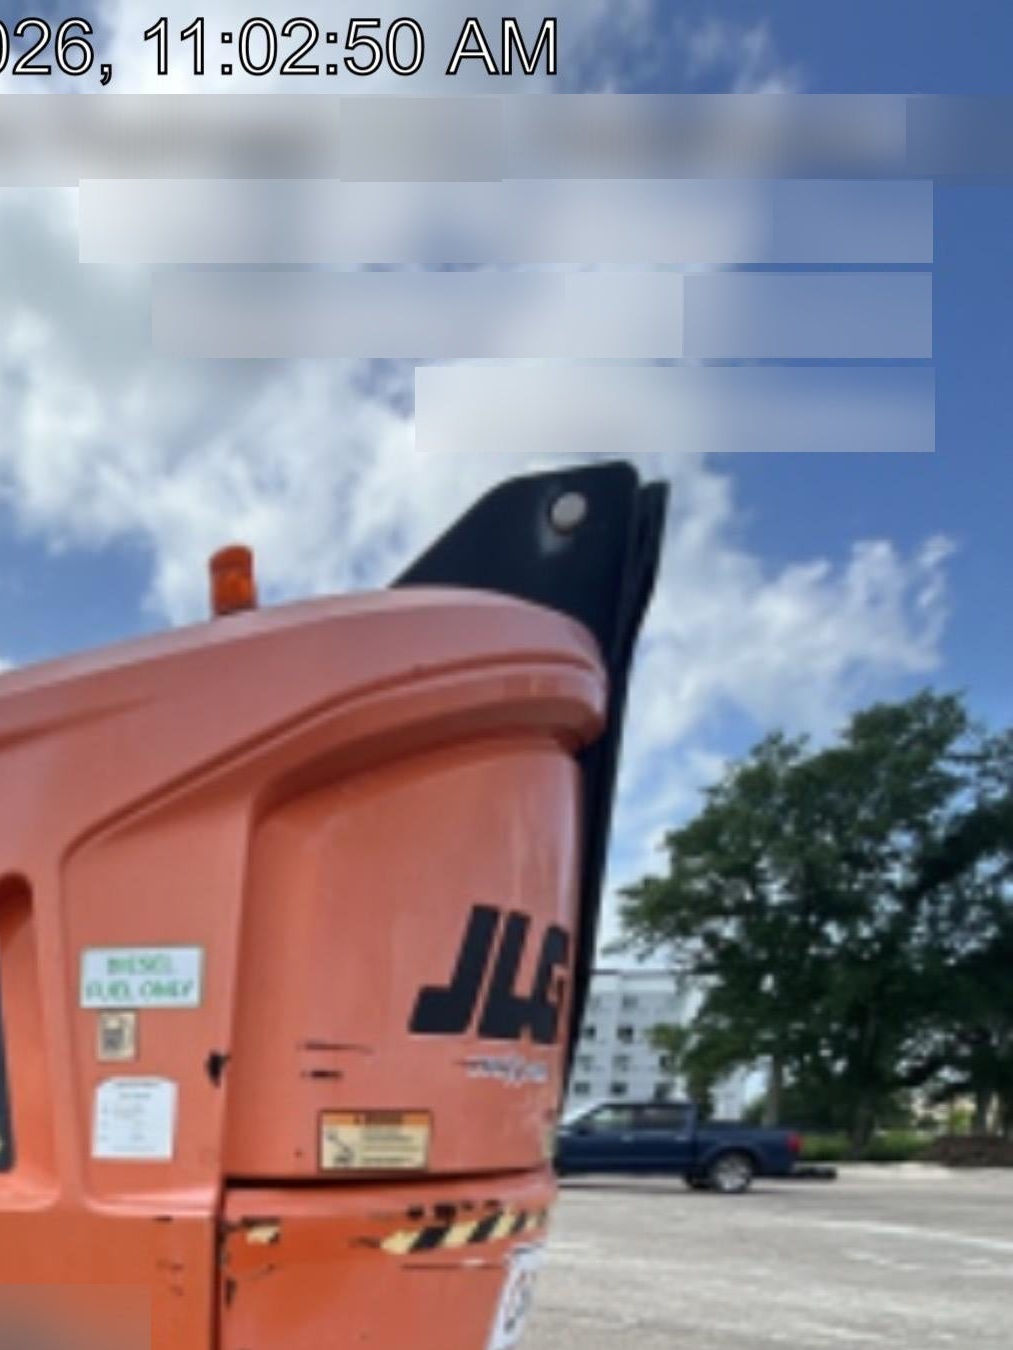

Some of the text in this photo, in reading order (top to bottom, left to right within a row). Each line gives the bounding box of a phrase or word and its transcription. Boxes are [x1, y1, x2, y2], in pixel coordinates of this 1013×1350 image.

[86, 979, 196, 1002] FUEL ONLY
[408, 903, 570, 1045] JLG
